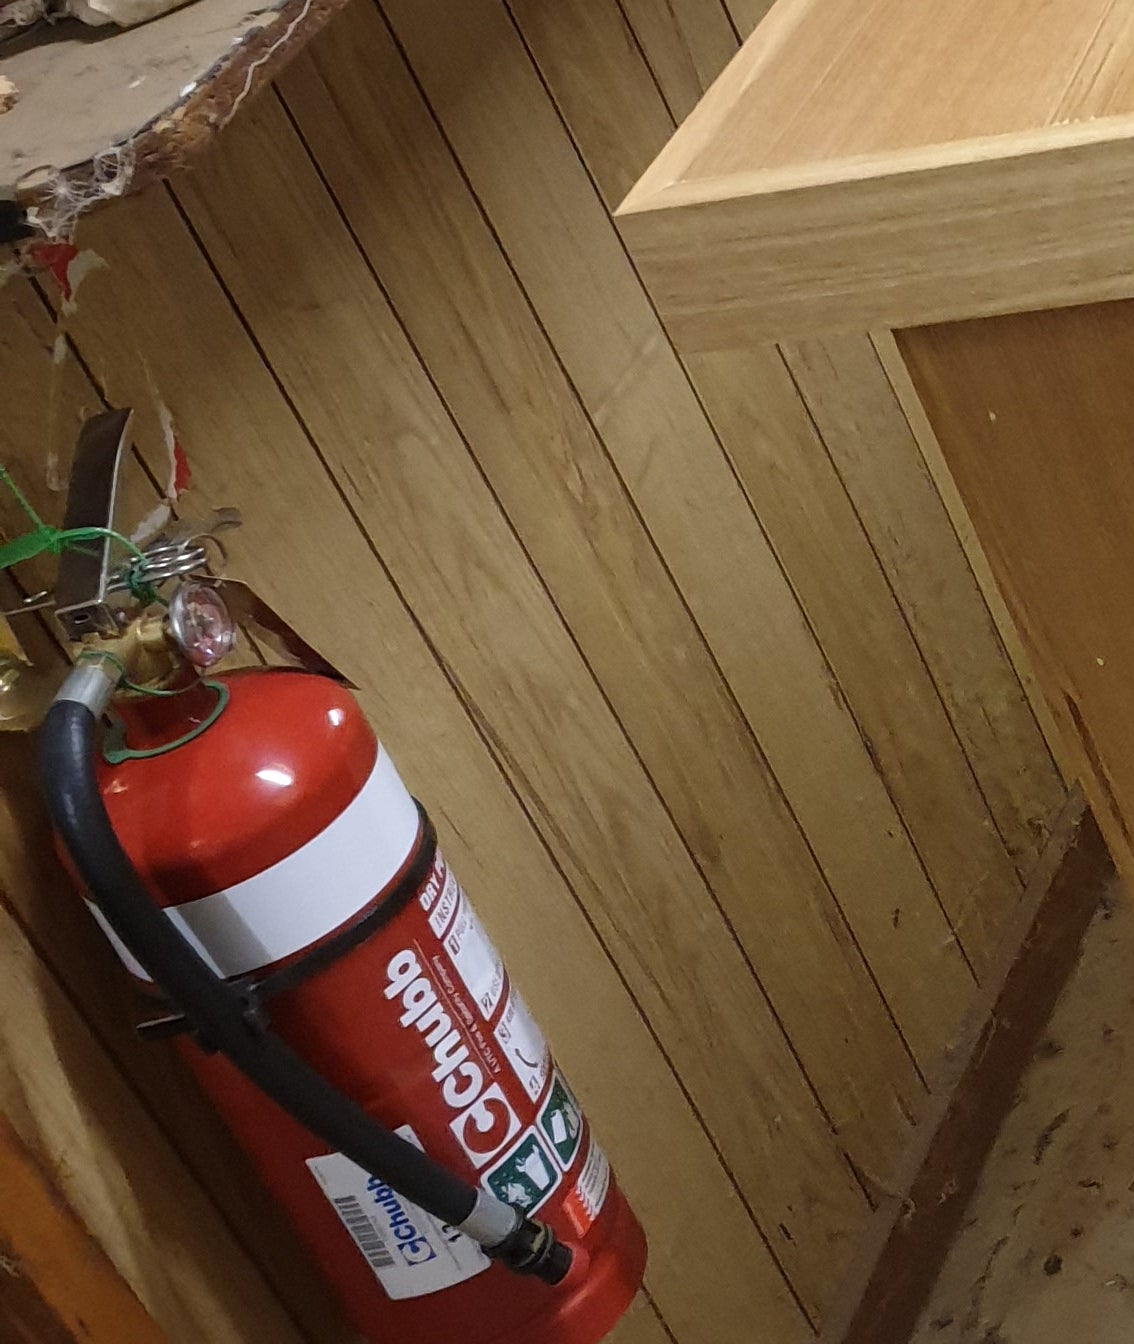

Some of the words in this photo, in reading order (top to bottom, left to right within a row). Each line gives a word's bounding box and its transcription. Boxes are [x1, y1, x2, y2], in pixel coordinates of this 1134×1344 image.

[420, 873, 440, 911] DRY
[383, 949, 484, 1109] Chubb
[367, 1176, 417, 1240] Chubb
